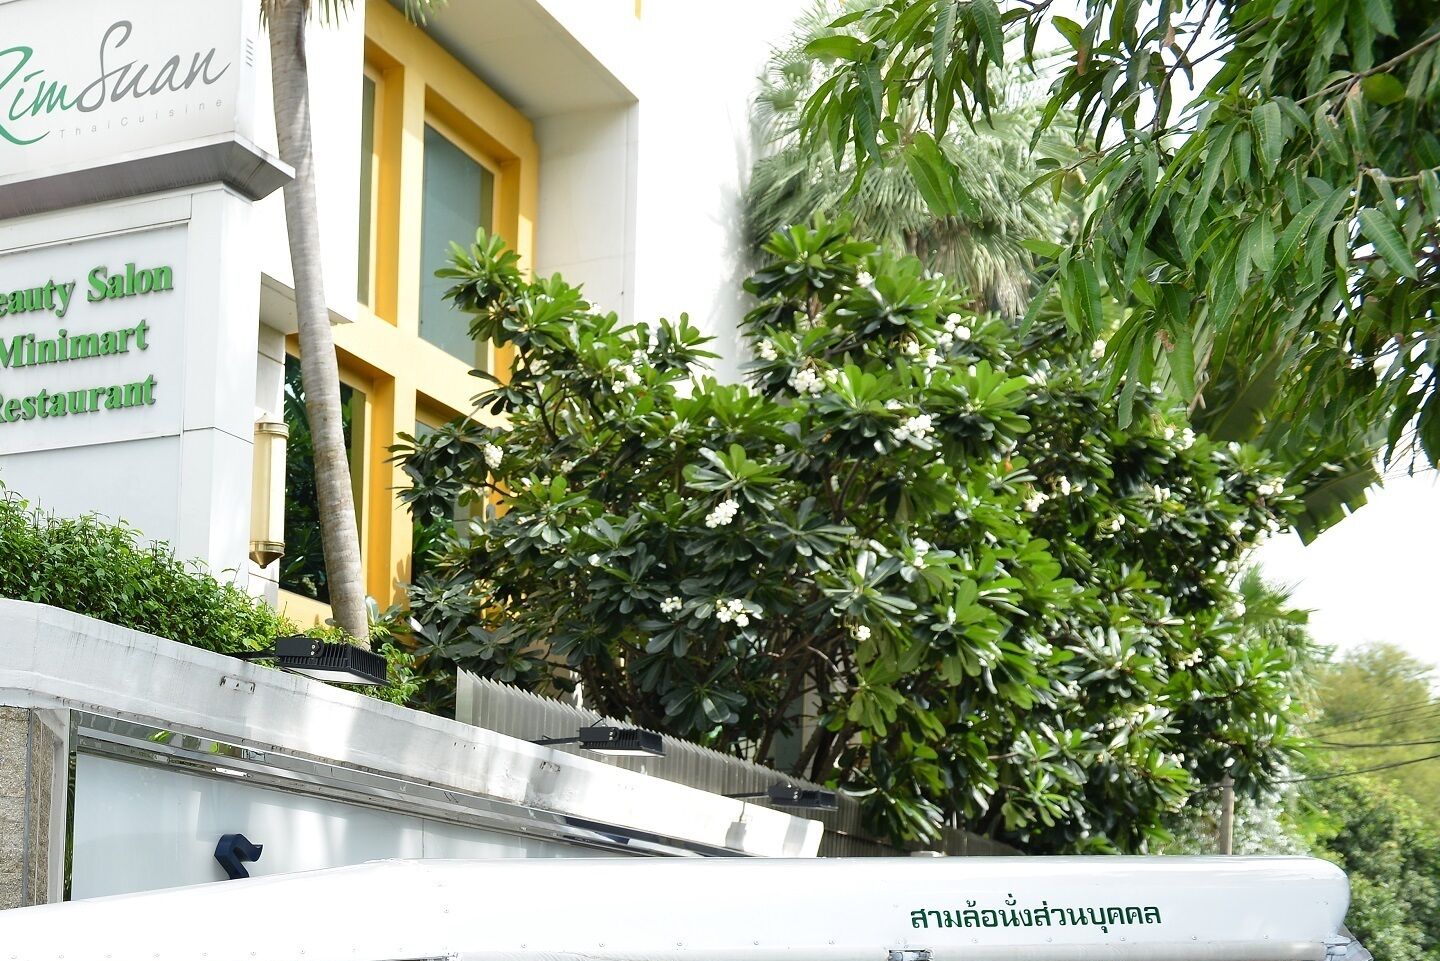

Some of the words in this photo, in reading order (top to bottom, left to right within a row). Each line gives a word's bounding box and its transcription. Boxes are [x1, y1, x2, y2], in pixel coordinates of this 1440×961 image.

[87, 261, 174, 304] Salon
[910, 893, 1162, 934] สามล้อนั่งส่วนบุคคล
